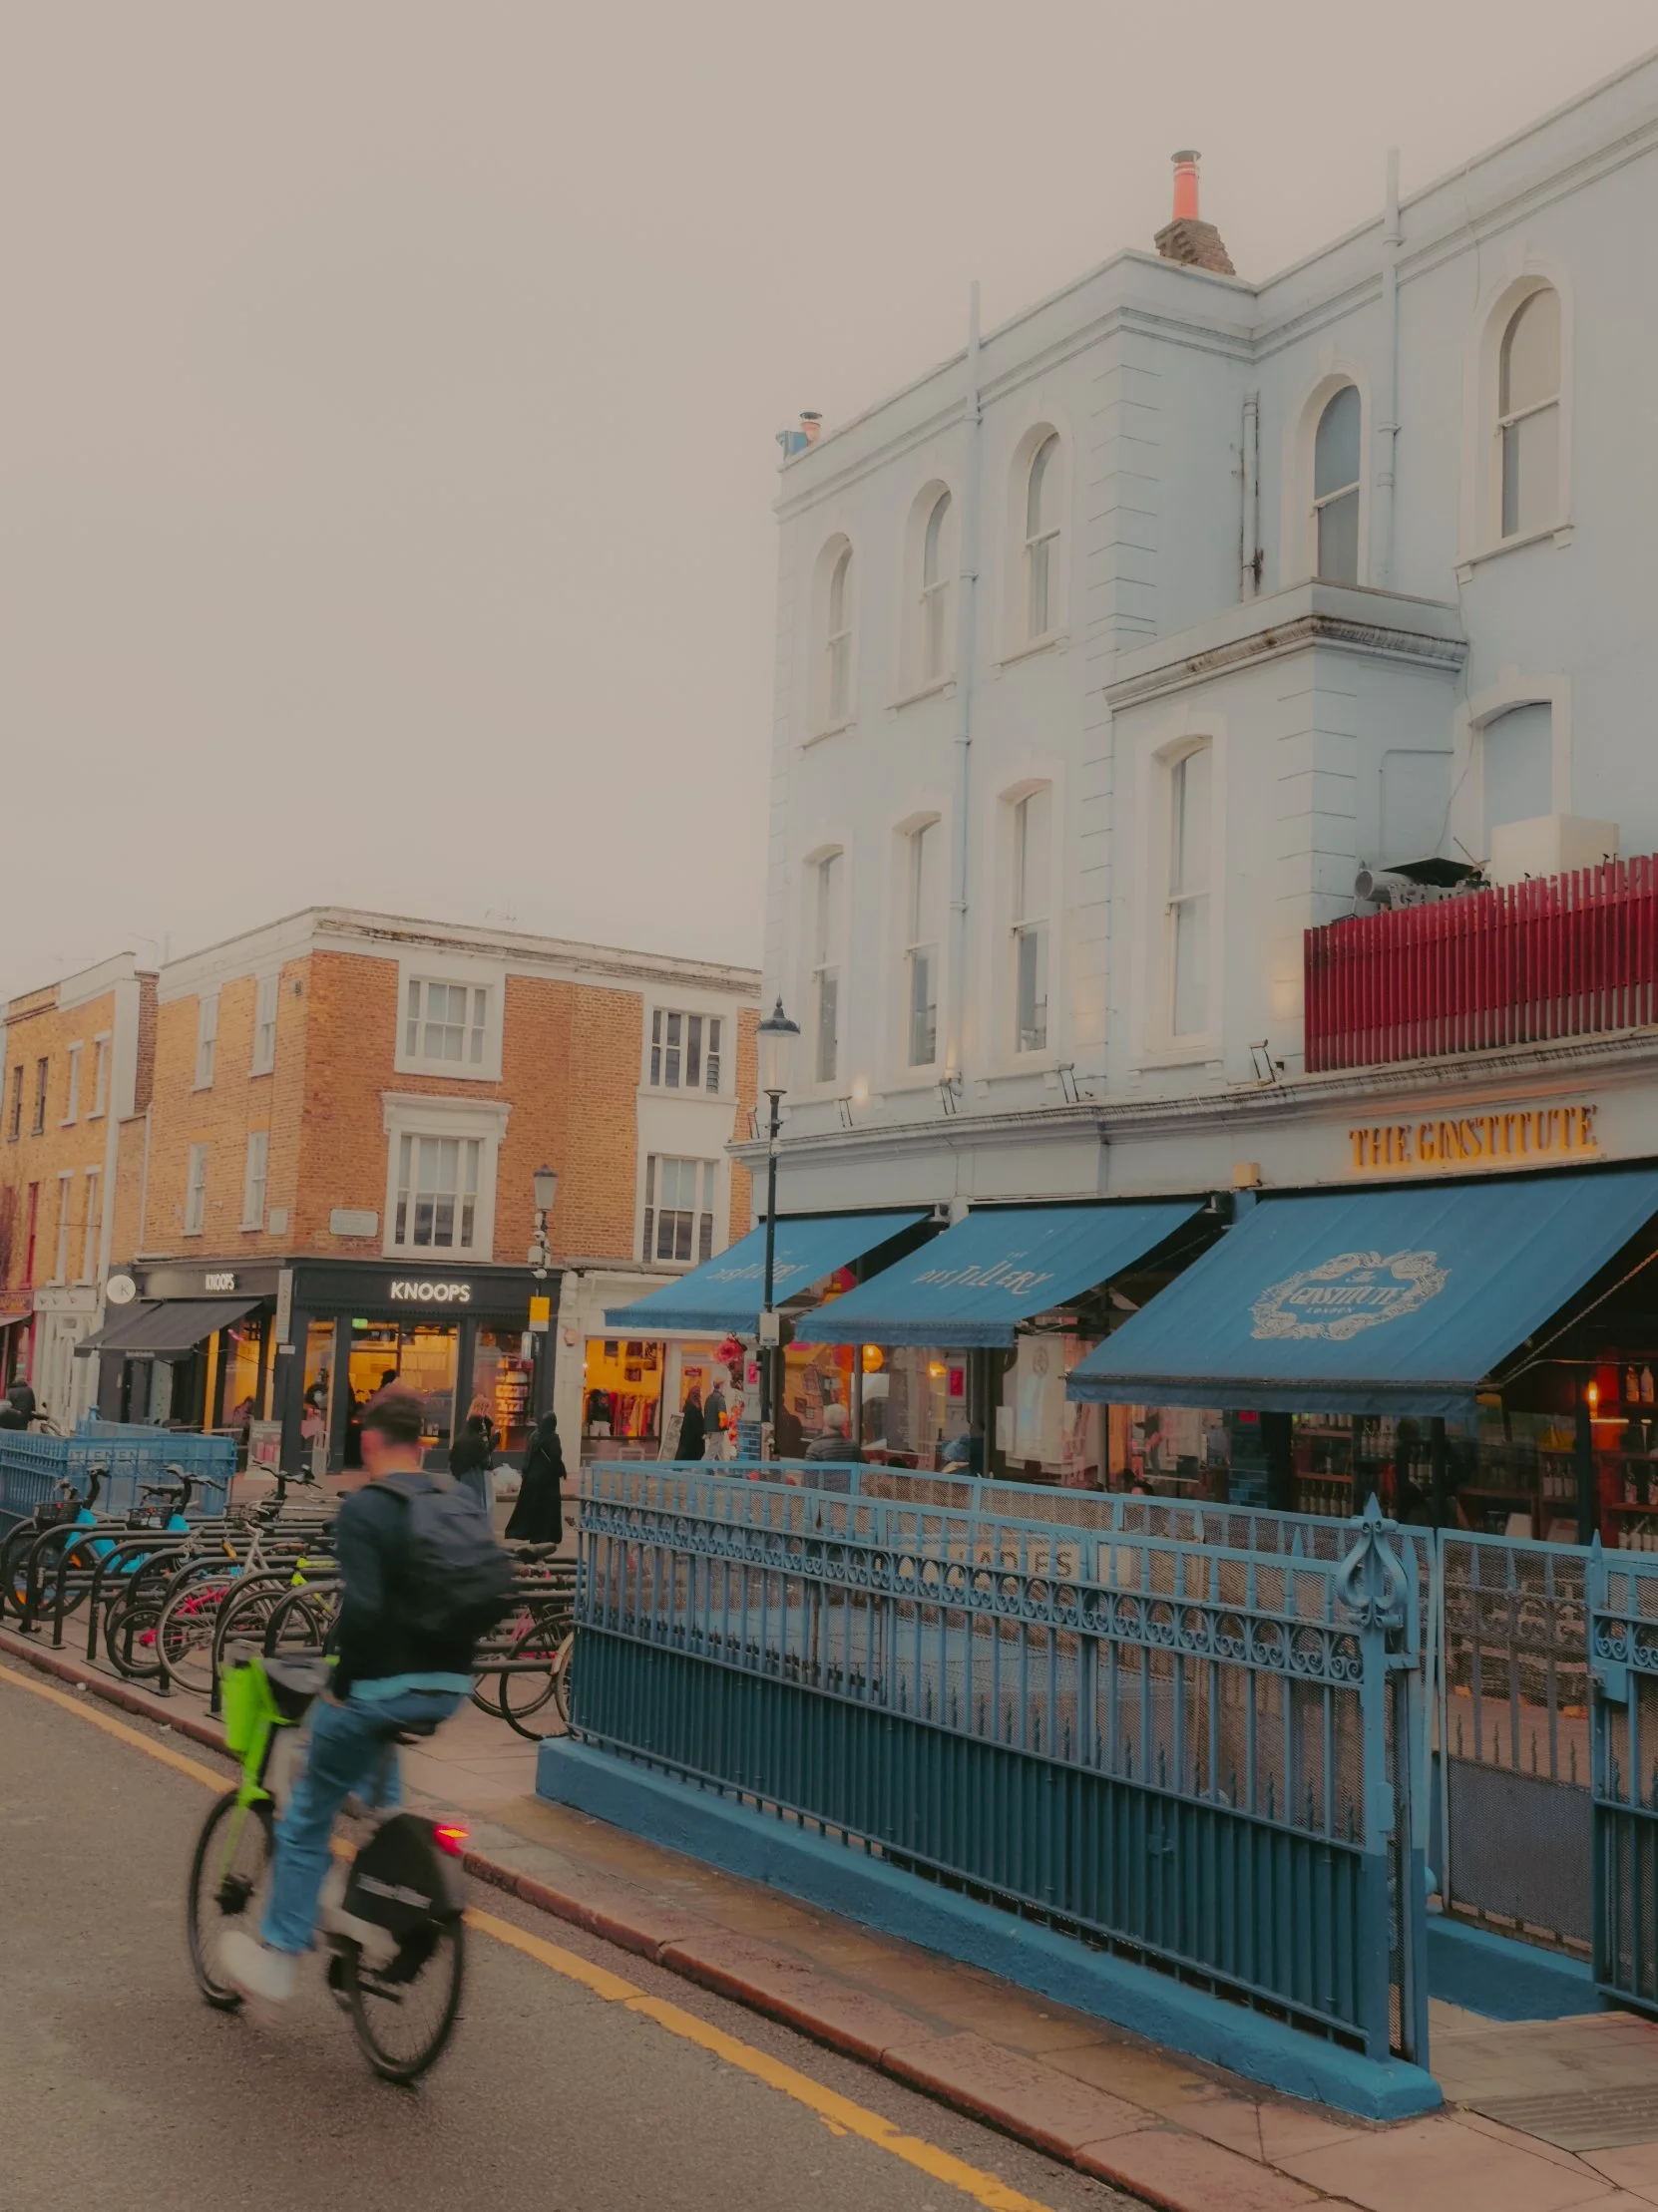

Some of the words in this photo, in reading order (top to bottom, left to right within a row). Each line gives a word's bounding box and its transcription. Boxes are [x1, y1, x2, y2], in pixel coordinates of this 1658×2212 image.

[1350, 1124, 1412, 1167] THE
[1415, 1104, 1597, 1162] GINSTITUTE
[205, 1273, 235, 1291] KNOOPS
[910, 1260, 1054, 1294] DISTILLERY
[120, 1284, 131, 1296] K
[390, 1281, 471, 1302] KNOOPS
[1289, 1286, 1405, 1305] GINSTITUTE
